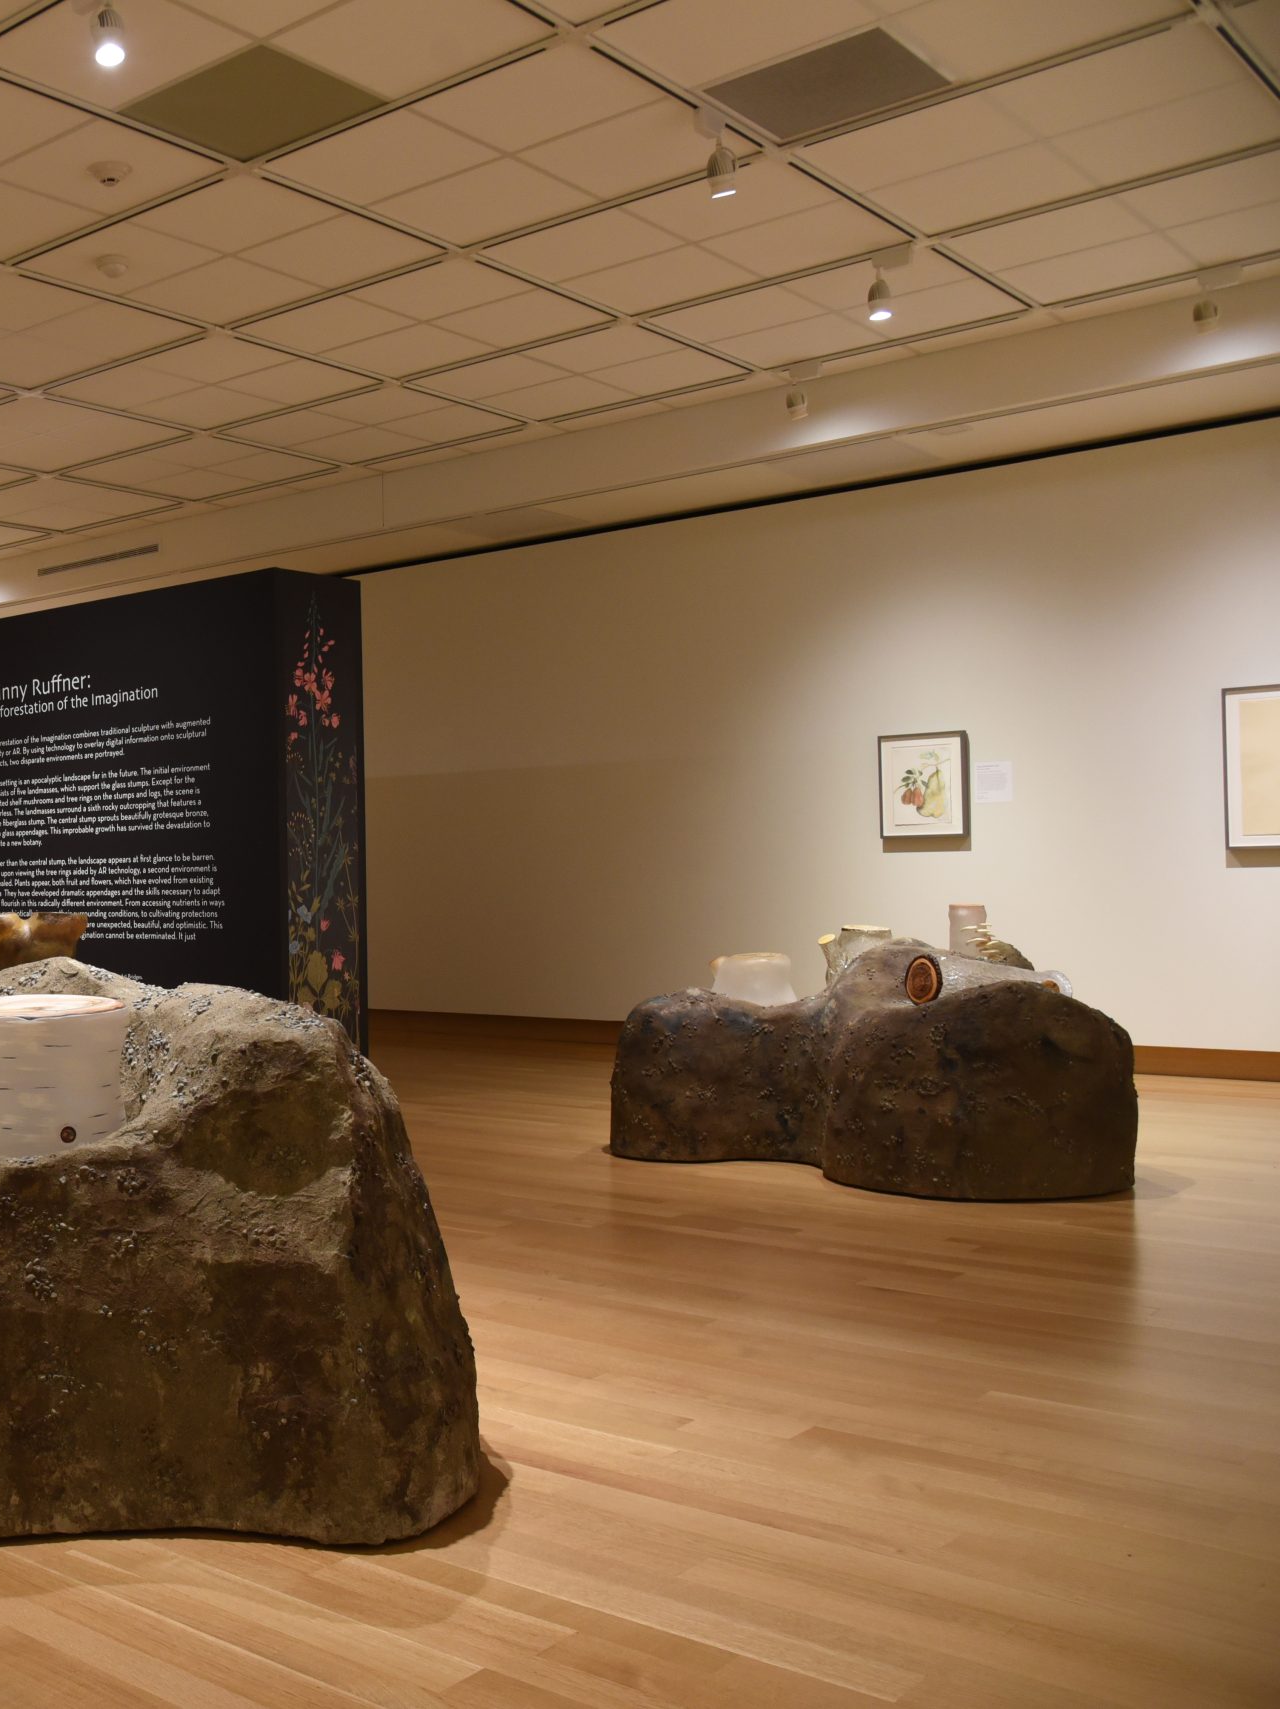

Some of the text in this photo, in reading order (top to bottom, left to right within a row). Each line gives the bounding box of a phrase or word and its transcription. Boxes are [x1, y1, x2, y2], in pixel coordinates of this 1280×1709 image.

[33, 674, 91, 696] Ruffner:
[57, 696, 68, 711] of
[71, 695, 89, 709] the
[92, 687, 158, 707] Imagination
[41, 733, 72, 744] Imagination
[72, 730, 100, 740] combines
[101, 725, 131, 736] traditional
[132, 724, 160, 737] sculpture
[161, 721, 175, 730] with
[176, 718, 211, 731] augmented
[31, 746, 45, 755] using
[46, 743, 76, 752] technology
[84, 739, 105, 749] overlay
[106, 737, 124, 748] digital
[124, 735, 159, 744] information
[176, 728, 207, 740] sculptural
[20, 754, 46, 766] disparate
[46, 752, 84, 763] environments
[31, 776, 62, 787] apocalyptic
[63, 773, 92, 785] landscape
[92, 771, 101, 780] far
[108, 770, 119, 779] the
[140, 768, 152, 776] The
[153, 766, 170, 775] initial
[171, 763, 210, 774] environment
[60, 784, 77, 792] which
[78, 783, 100, 793] support
[101, 782, 111, 790] the
[112, 781, 127, 791] glass
[152, 778, 173, 788] Except
[174, 776, 183, 784] for
[185, 776, 196, 784] the
[23, 797, 54, 806] mushrooms
[54, 795, 66, 804] and
[79, 794, 93, 805] rings
[102, 792, 113, 800] the
[114, 792, 135, 801] stumps
[136, 790, 148, 798] and
[163, 788, 174, 796] the
[25, 807, 56, 816] landmasses
[57, 804, 82, 814] surround
[88, 804, 102, 812] sixth
[102, 802, 119, 812] rocky
[120, 801, 156, 814] outcropping
[47, 817, 58, 825] The
[58, 815, 78, 824] central
[79, 816, 97, 826] stump
[98, 814, 120, 825] sprouts
[120, 811, 152, 823] beautifully
[153, 811, 184, 822] grotesque
[2, 828, 15, 839] glass
[50, 827, 62, 835] This
[62, 825, 95, 836] improbable
[95, 824, 116, 835] growth
[116, 824, 128, 832] has
[128, 822, 154, 832] survived
[154, 822, 165, 830] the
[166, 821, 202, 830] devastation
[29, 858, 48, 866] central
[68, 857, 78, 865] the
[78, 856, 108, 868] landscape
[108, 858, 132, 867] appears
[140, 855, 152, 863] first
[153, 854, 173, 866] glance
[1, 872, 15, 880] upon
[15, 869, 36, 880] viewing
[58, 868, 72, 879] rings
[73, 867, 89, 876] aided
[148, 865, 170, 874] second
[171, 865, 211, 873] environment
[52, 878, 66, 886] both
[66, 877, 79, 886] fruit
[79, 878, 90, 886] and
[114, 877, 132, 885] which
[132, 876, 147, 885] have
[148, 876, 172, 885] evolved
[173, 876, 188, 884] from
[190, 876, 214, 886] existing
[4, 889, 17, 900] They
[31, 888, 60, 899] developed
[61, 888, 85, 897] dramatic
[86, 888, 121, 898] appendages
[122, 888, 134, 896] and
[134, 887, 145, 896] the
[146, 887, 161, 896] skills
[202, 887, 221, 897] adapt
[38, 899, 61, 908] radically
[61, 898, 86, 907] different
[125, 898, 141, 907] From
[142, 899, 172, 910] accessing
[149, 909, 181, 921] cultivating
[182, 911, 218, 919] protections
[163, 921, 175, 929] and
[184, 933, 196, 942] just
